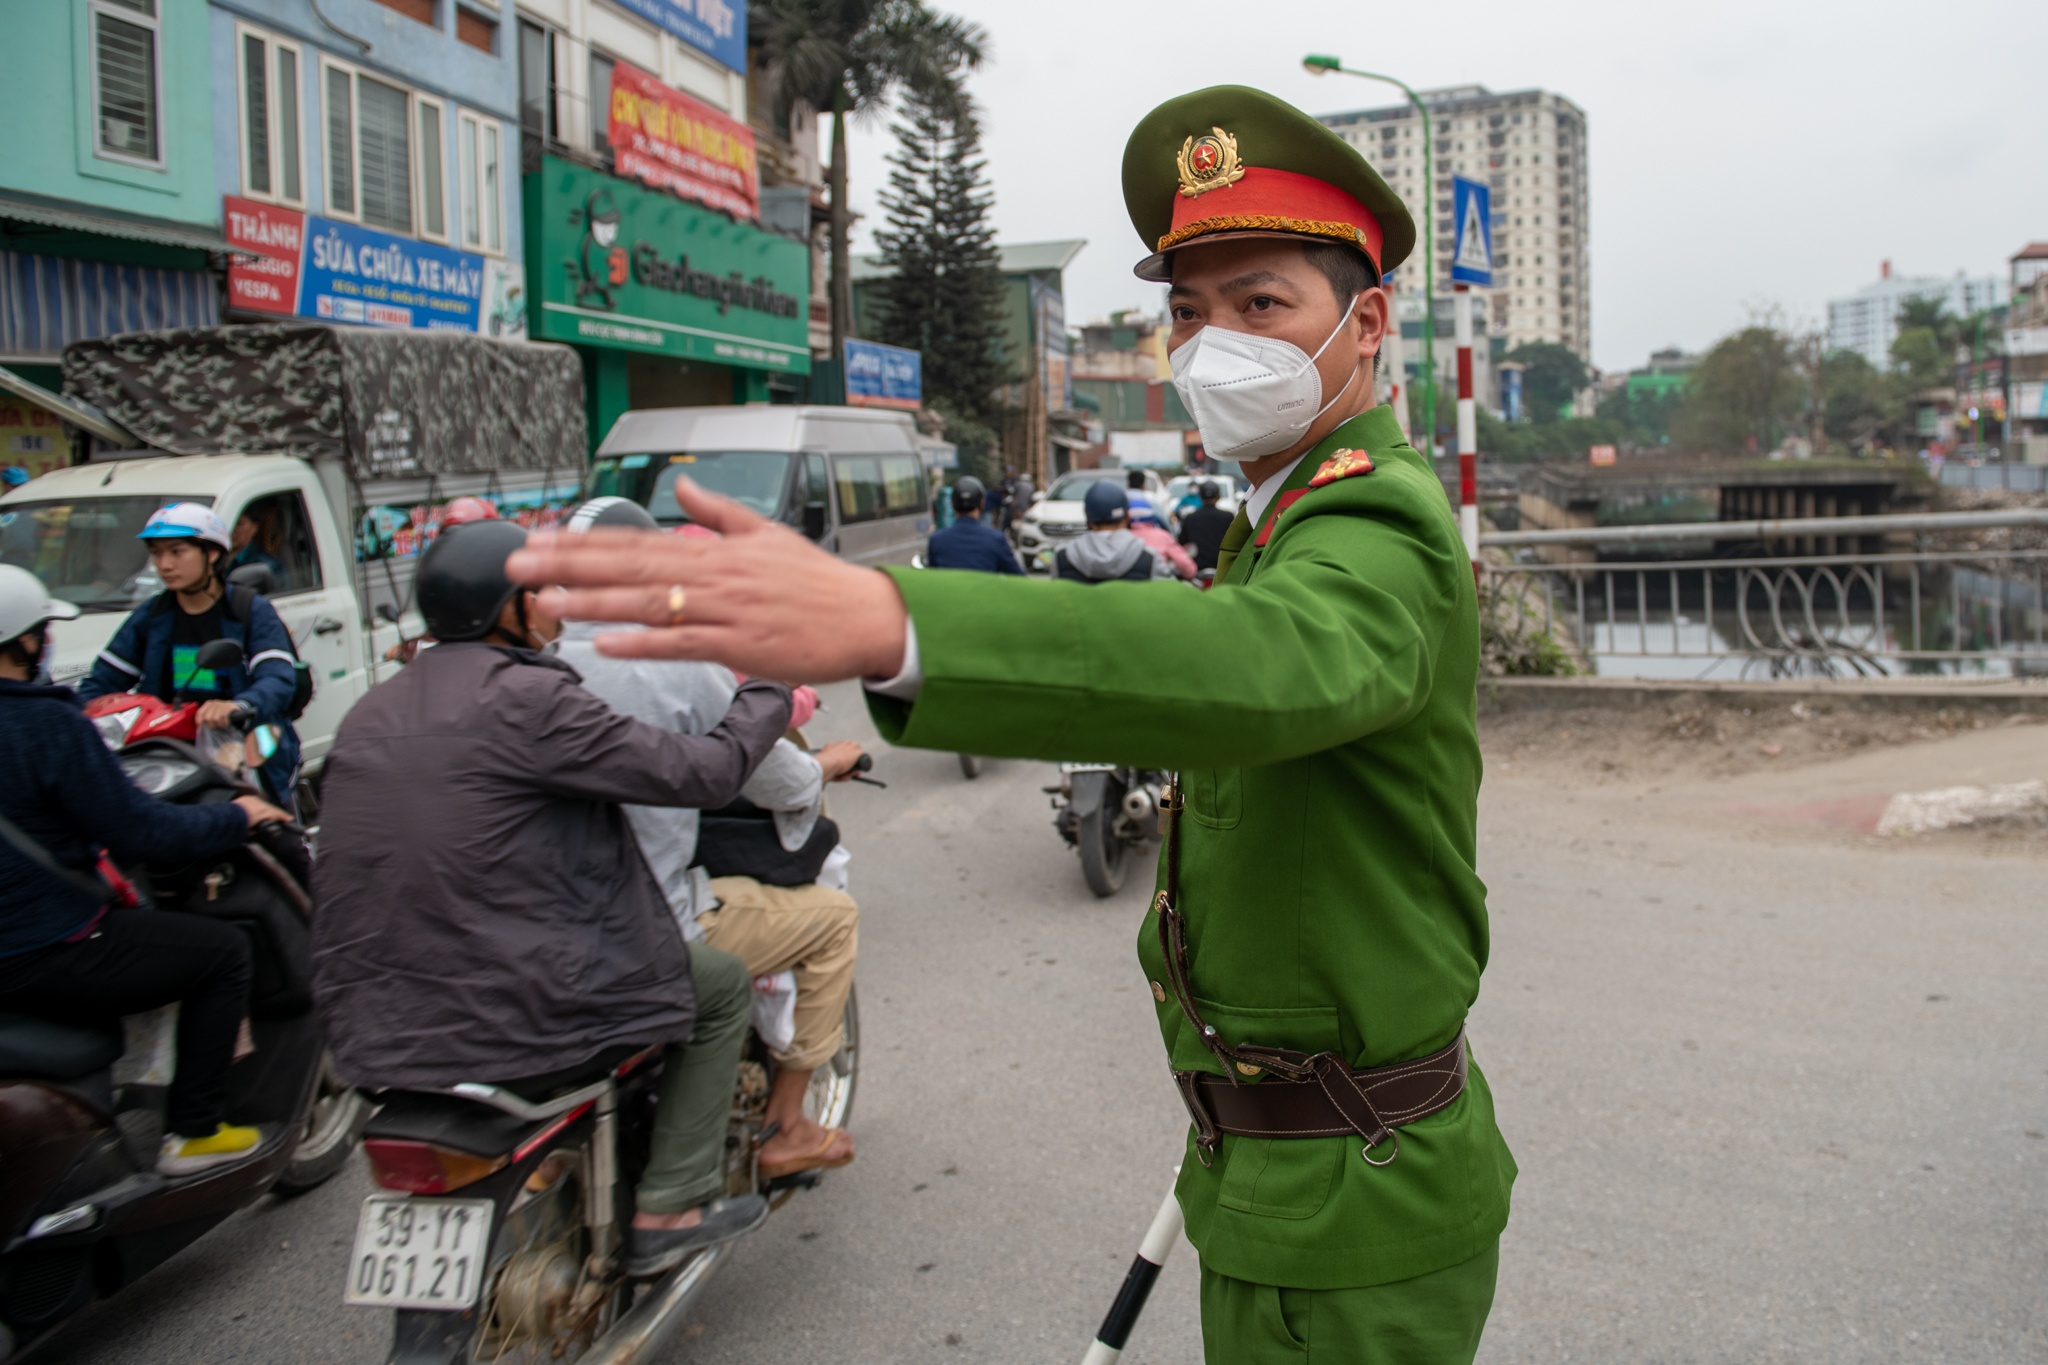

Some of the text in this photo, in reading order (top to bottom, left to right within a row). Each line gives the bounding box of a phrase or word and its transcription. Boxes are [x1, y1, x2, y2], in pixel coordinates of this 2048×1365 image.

[312, 227, 482, 299] SỬA CHỮA XE MÁY
[233, 277, 282, 302] VESPA
[357, 1253, 469, 1299] 061.21
